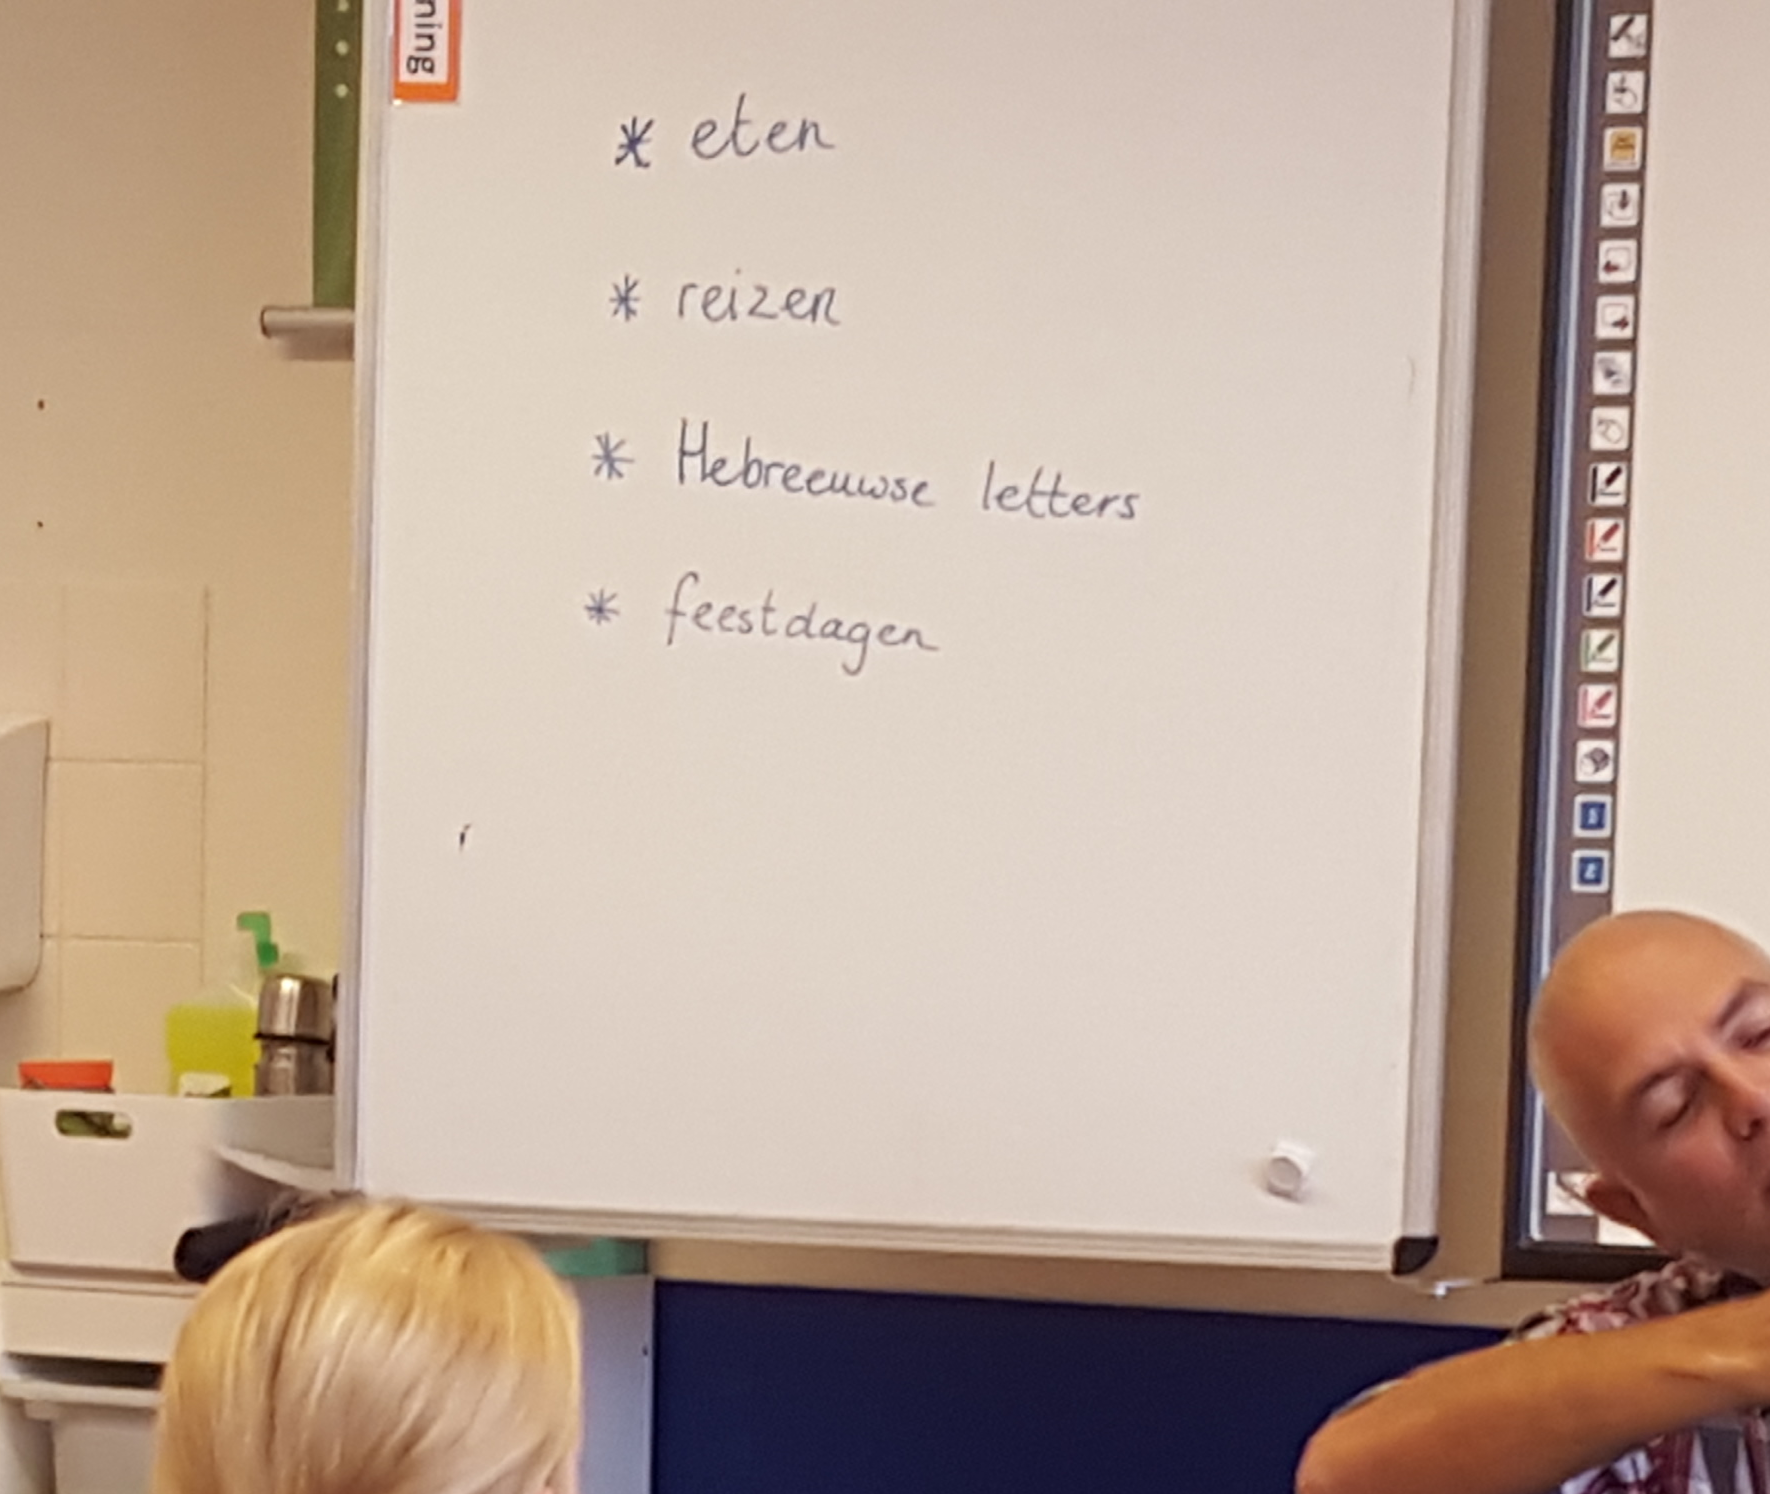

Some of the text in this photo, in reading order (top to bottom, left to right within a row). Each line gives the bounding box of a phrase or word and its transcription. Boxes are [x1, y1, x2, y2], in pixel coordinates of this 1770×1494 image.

[690, 92, 836, 161] eten
[677, 268, 842, 326] reizen
[677, 418, 1140, 521] Hebreeuwse letters
[665, 570, 939, 677] feestdagen
